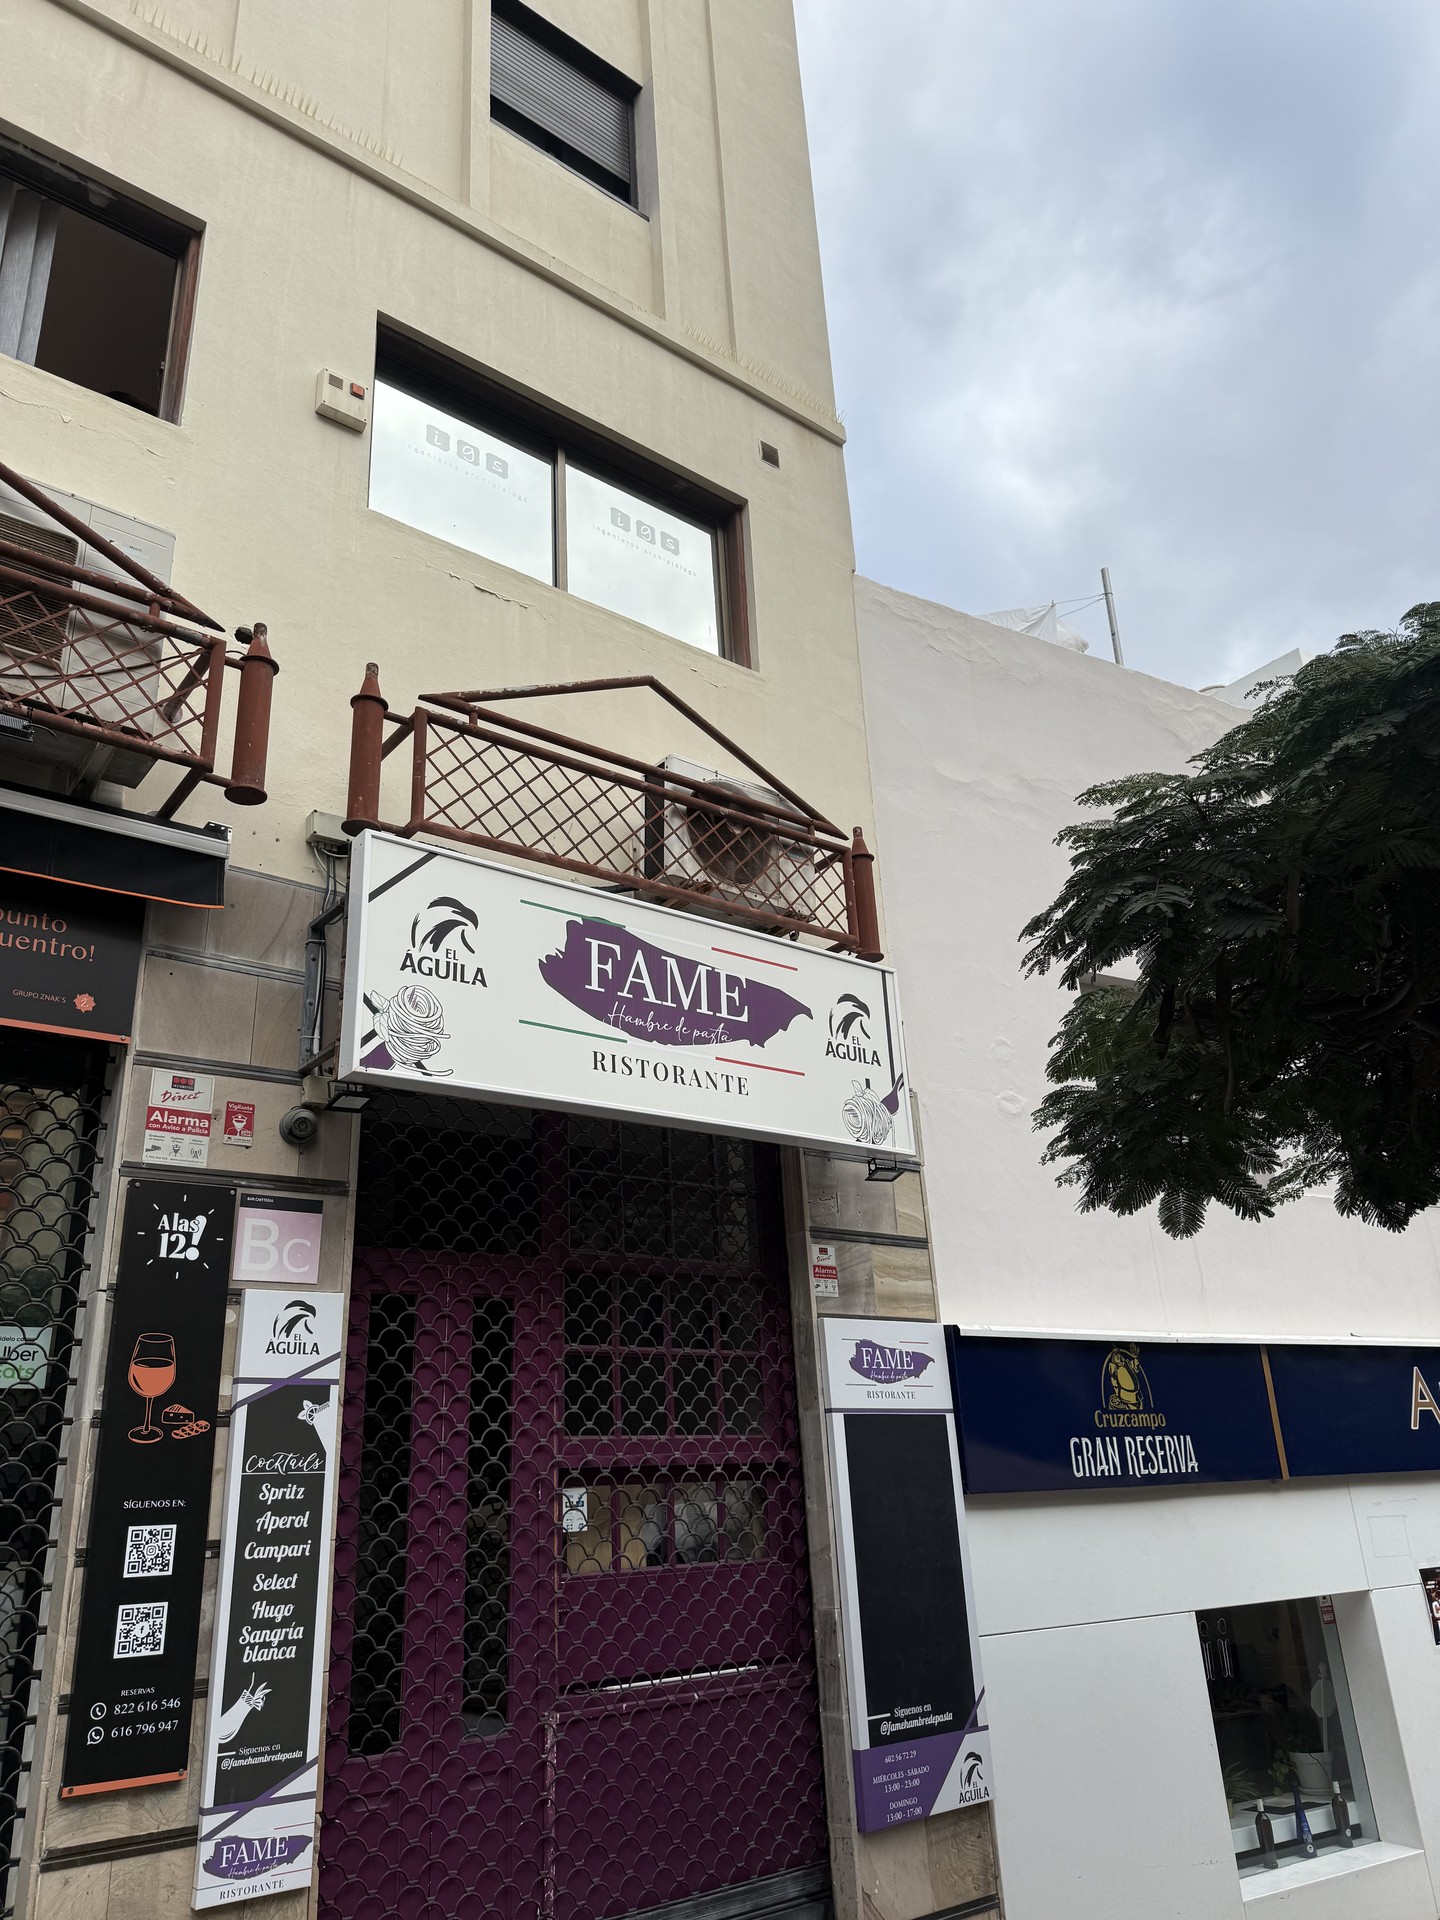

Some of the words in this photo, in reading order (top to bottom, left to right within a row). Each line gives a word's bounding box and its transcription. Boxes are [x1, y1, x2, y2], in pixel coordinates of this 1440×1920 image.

[445, 948, 459, 961] EL
[399, 949, 488, 988] ÁGUILA
[585, 937, 749, 1023] FAME
[12, 989, 39, 999] GRUPO
[607, 1001, 672, 1032] Hambre
[675, 1016, 691, 1042] de
[692, 1022, 733, 1045] pasta
[851, 1035, 861, 1046] EL
[825, 1037, 882, 1068] ÁGUILA
[592, 1050, 749, 1096] RISTORANTE
[161, 1090, 205, 1103] Direct
[228, 1102, 253, 1112] Vigilante
[149, 1110, 209, 1128] Alarma
[162, 1122, 181, 1131] Aviso
[814, 1266, 836, 1275] Alarma
[293, 1333, 303, 1341] EL
[265, 1338, 321, 1356] ÁGUILA
[861, 1347, 914, 1370] FAME
[866, 1390, 916, 1400] RISTORANTE
[1094, 1409, 1167, 1431] Cruzcampo
[1069, 1436, 1122, 1478] GRAN
[1124, 1434, 1199, 1478] RESERVA
[123, 1498, 171, 1509] SÍGUENOS
[172, 1499, 187, 1508] EN:
[258, 1482, 306, 1506] Spritz
[256, 1510, 311, 1535] Aperol
[244, 1539, 312, 1563] Campari
[253, 1572, 298, 1592] Select
[251, 1600, 296, 1623] Hugo
[239, 1621, 304, 1647] Sangría
[242, 1644, 298, 1664] blanca
[120, 1686, 155, 1697] RESERVAS
[113, 1702, 135, 1715] 822
[137, 1699, 158, 1713] 616
[160, 1696, 181, 1710] 546
[894, 1705, 923, 1718] Síguenos
[923, 1703, 932, 1712] en
[111, 1724, 133, 1738] 616
[135, 1722, 156, 1735] 796
[158, 1719, 179, 1733] 947
[880, 1711, 953, 1736] @famehambredepasta
[238, 1745, 271, 1756] Síguenos
[272, 1743, 281, 1751] en
[884, 1754, 895, 1764] 602
[895, 1752, 902, 1762] 56
[910, 1750, 917, 1758] 29
[221, 1750, 304, 1771] @famehambredepasta
[872, 1770, 905, 1785] MIÉRCOLES
[907, 1765, 930, 1777] SÁBADO
[884, 1782, 901, 1793] 13:00
[904, 1777, 920, 1789] 23:00
[889, 1796, 918, 1810] DOMINGO
[886, 1811, 903, 1823] 13:00
[906, 1806, 923, 1818] 17:00
[219, 1835, 290, 1868] FAME
[219, 1879, 285, 1900] RISTORANTE
